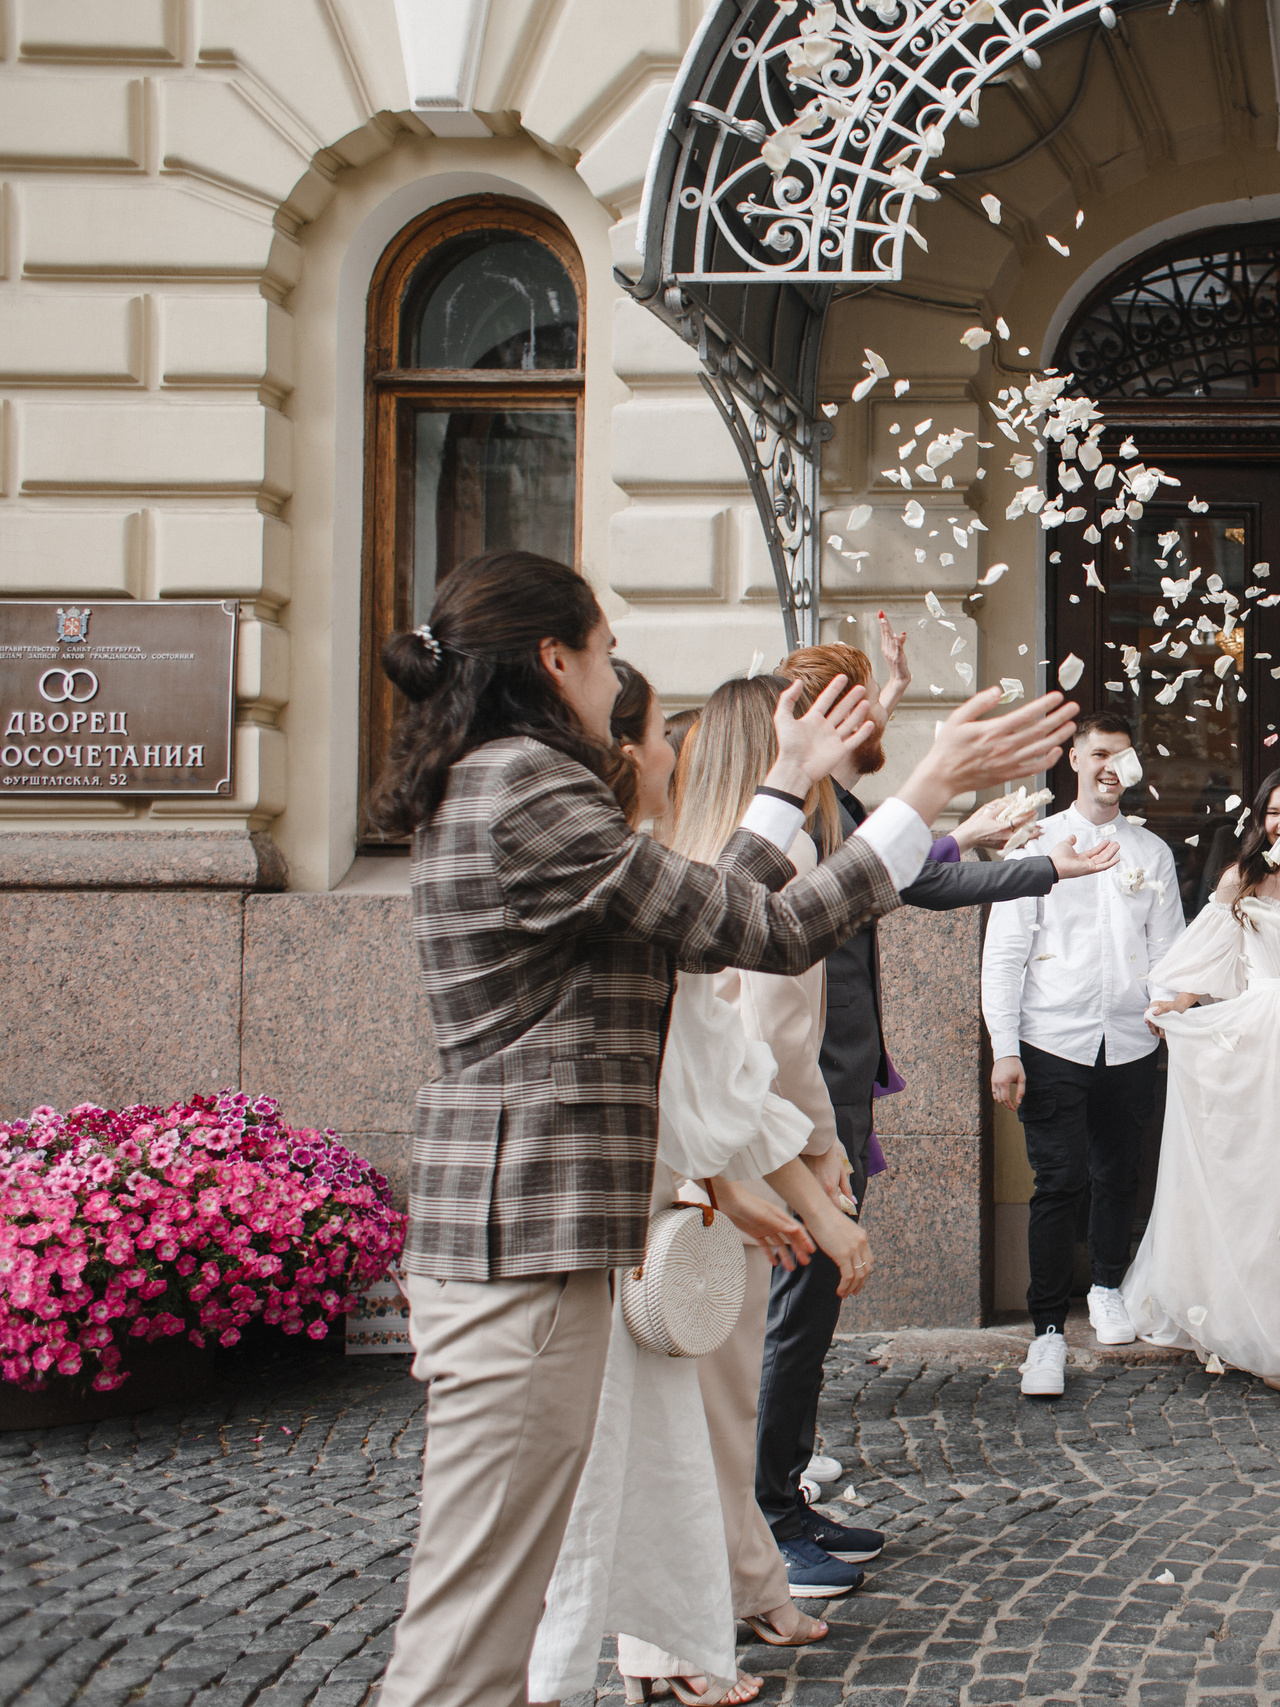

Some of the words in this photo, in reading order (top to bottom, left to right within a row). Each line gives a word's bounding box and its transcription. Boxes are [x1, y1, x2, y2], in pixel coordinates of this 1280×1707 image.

[66, 645, 142, 653] САНКТ-ПЕТЕРБУРГА
[5, 711, 128, 736] ДВОРЕЦ
[0, 745, 205, 767] ОСОЧЕТАНИЯ
[109, 774, 128, 786] 52
